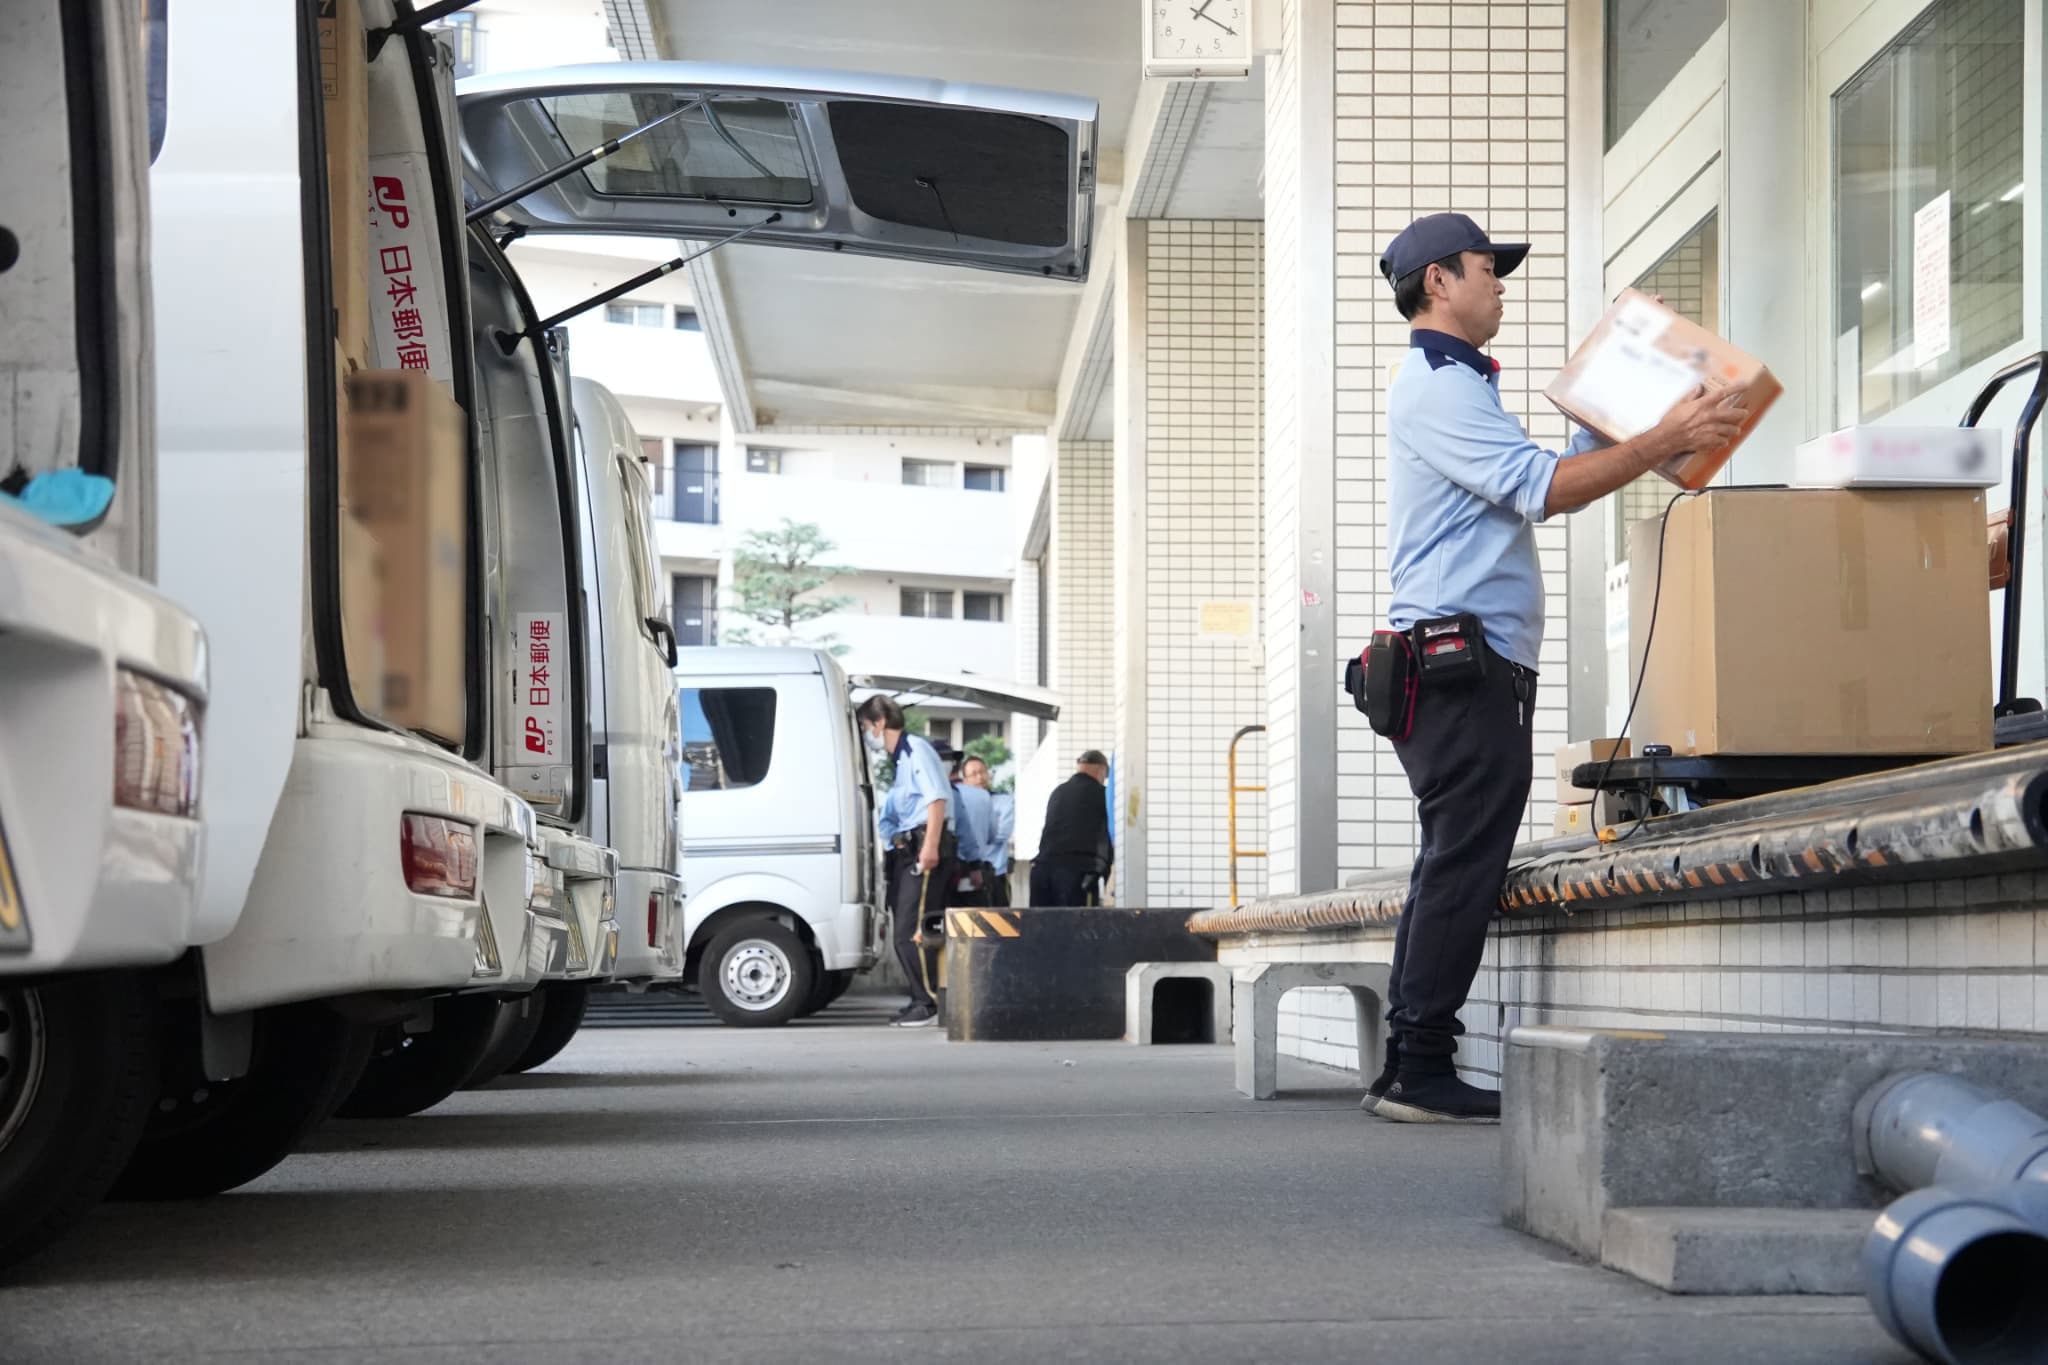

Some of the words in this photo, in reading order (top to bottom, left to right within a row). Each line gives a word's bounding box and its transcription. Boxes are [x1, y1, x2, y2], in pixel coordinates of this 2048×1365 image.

[1231, 8, 1238, 18] 3
[1165, 26, 1172, 36] 8
[1179, 38, 1185, 49] 7
[1195, 43, 1202, 54] 6
[1213, 38, 1220, 49] 5
[373, 176, 409, 229] JP
[379, 246, 430, 371] 日本郵便
[529, 620, 550, 706] 日本郵便
[525, 716, 545, 754] JP
